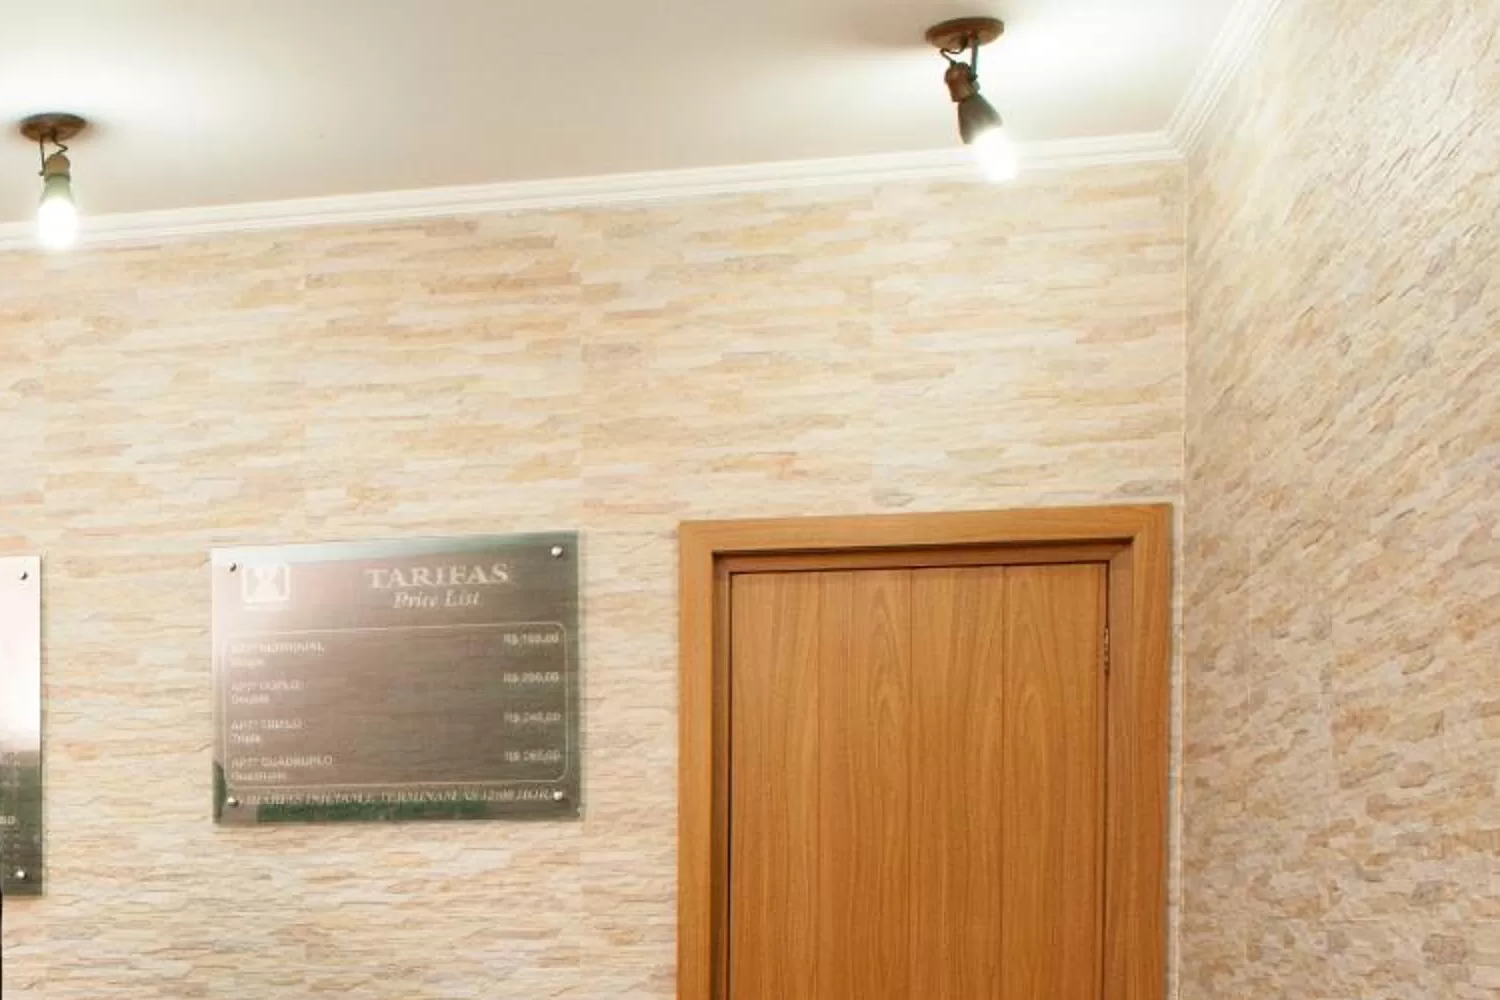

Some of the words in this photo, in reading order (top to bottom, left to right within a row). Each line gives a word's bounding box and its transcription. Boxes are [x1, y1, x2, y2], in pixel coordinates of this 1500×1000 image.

[363, 563, 509, 589] TARIFAS
[394, 591, 438, 609] Price
[444, 589, 480, 608] List
